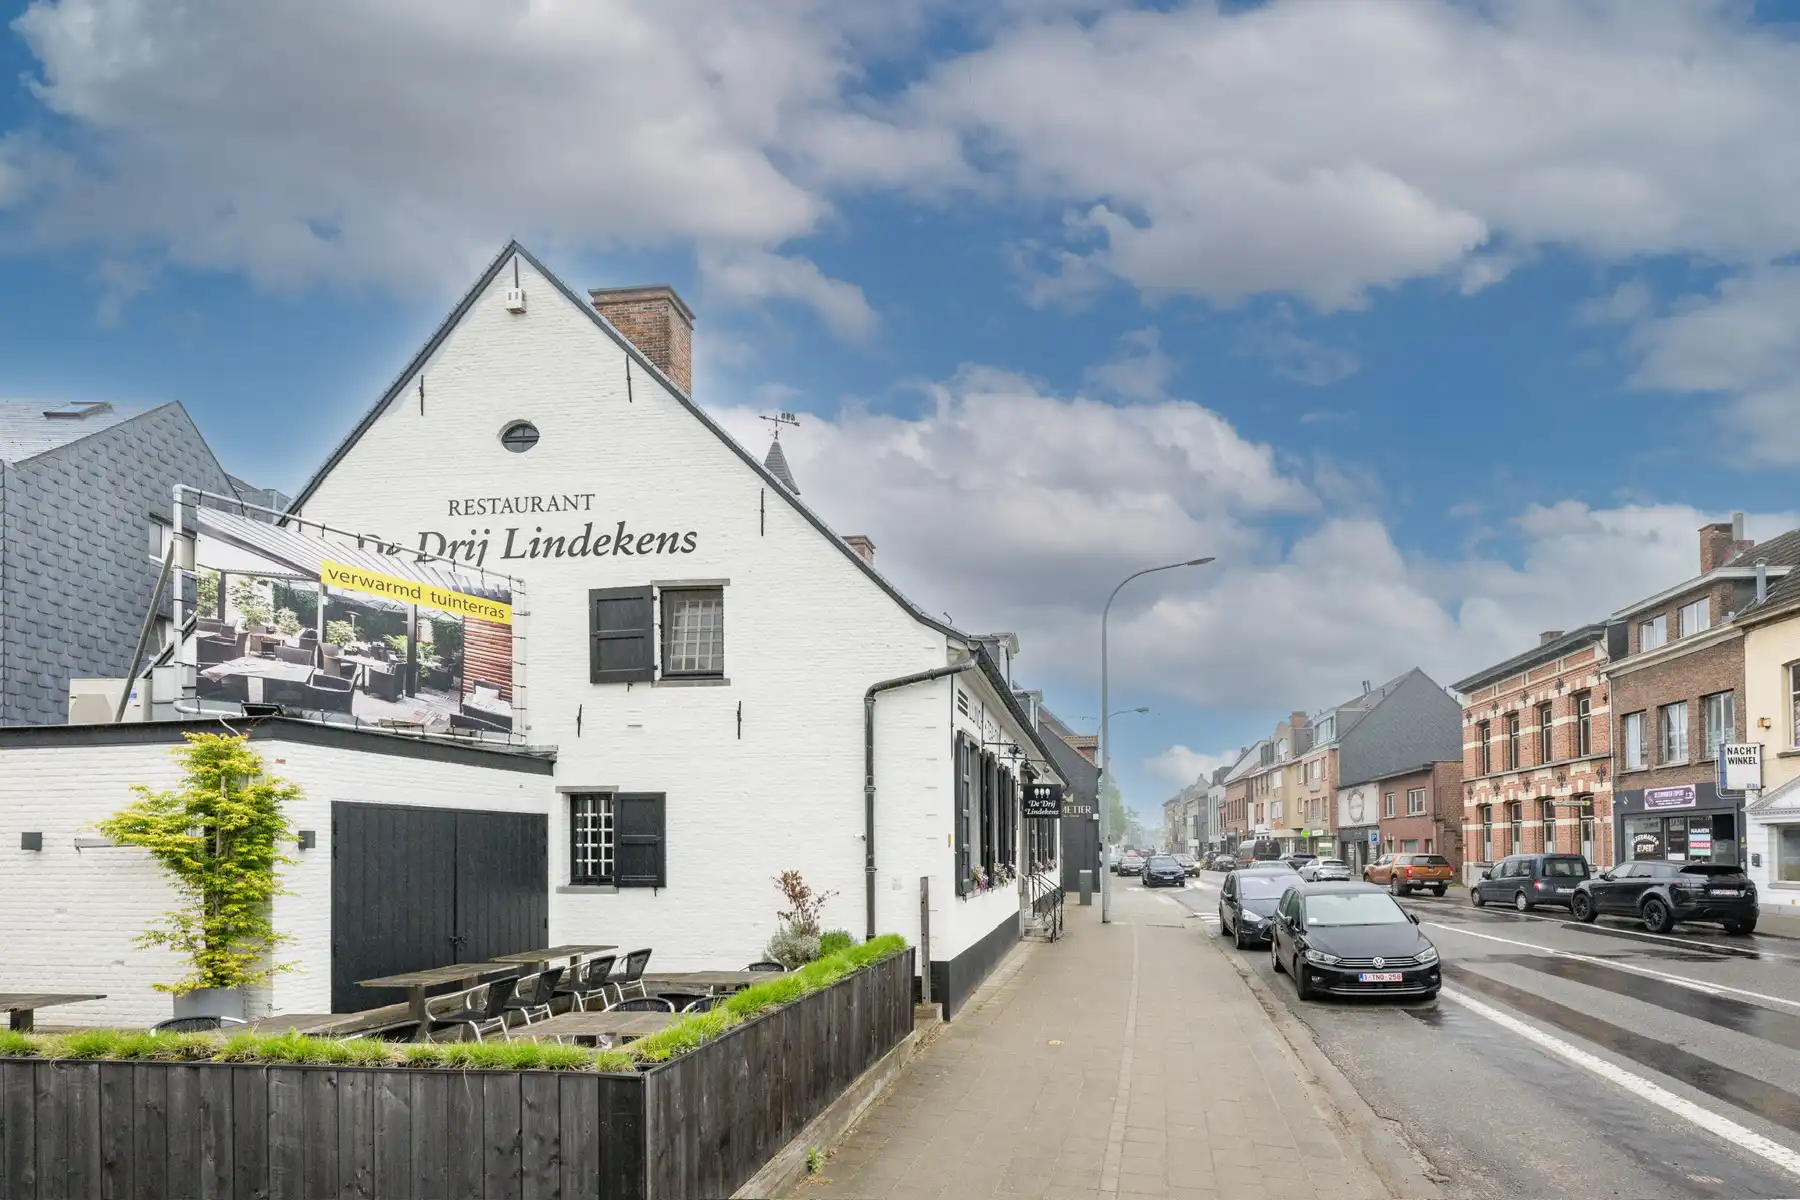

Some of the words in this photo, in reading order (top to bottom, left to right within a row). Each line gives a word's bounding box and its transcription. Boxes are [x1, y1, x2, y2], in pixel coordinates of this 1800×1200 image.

[448, 494, 596, 517] RESTAURANT
[412, 528, 491, 567] Drij
[500, 520, 698, 560] Lindekens
[328, 568, 422, 601] verwarmd
[430, 590, 505, 620] tuinterras
[1727, 746, 1757, 755] NACHT
[1727, 756, 1758, 765] WINKEL
[1040, 800, 1056, 809] Drij
